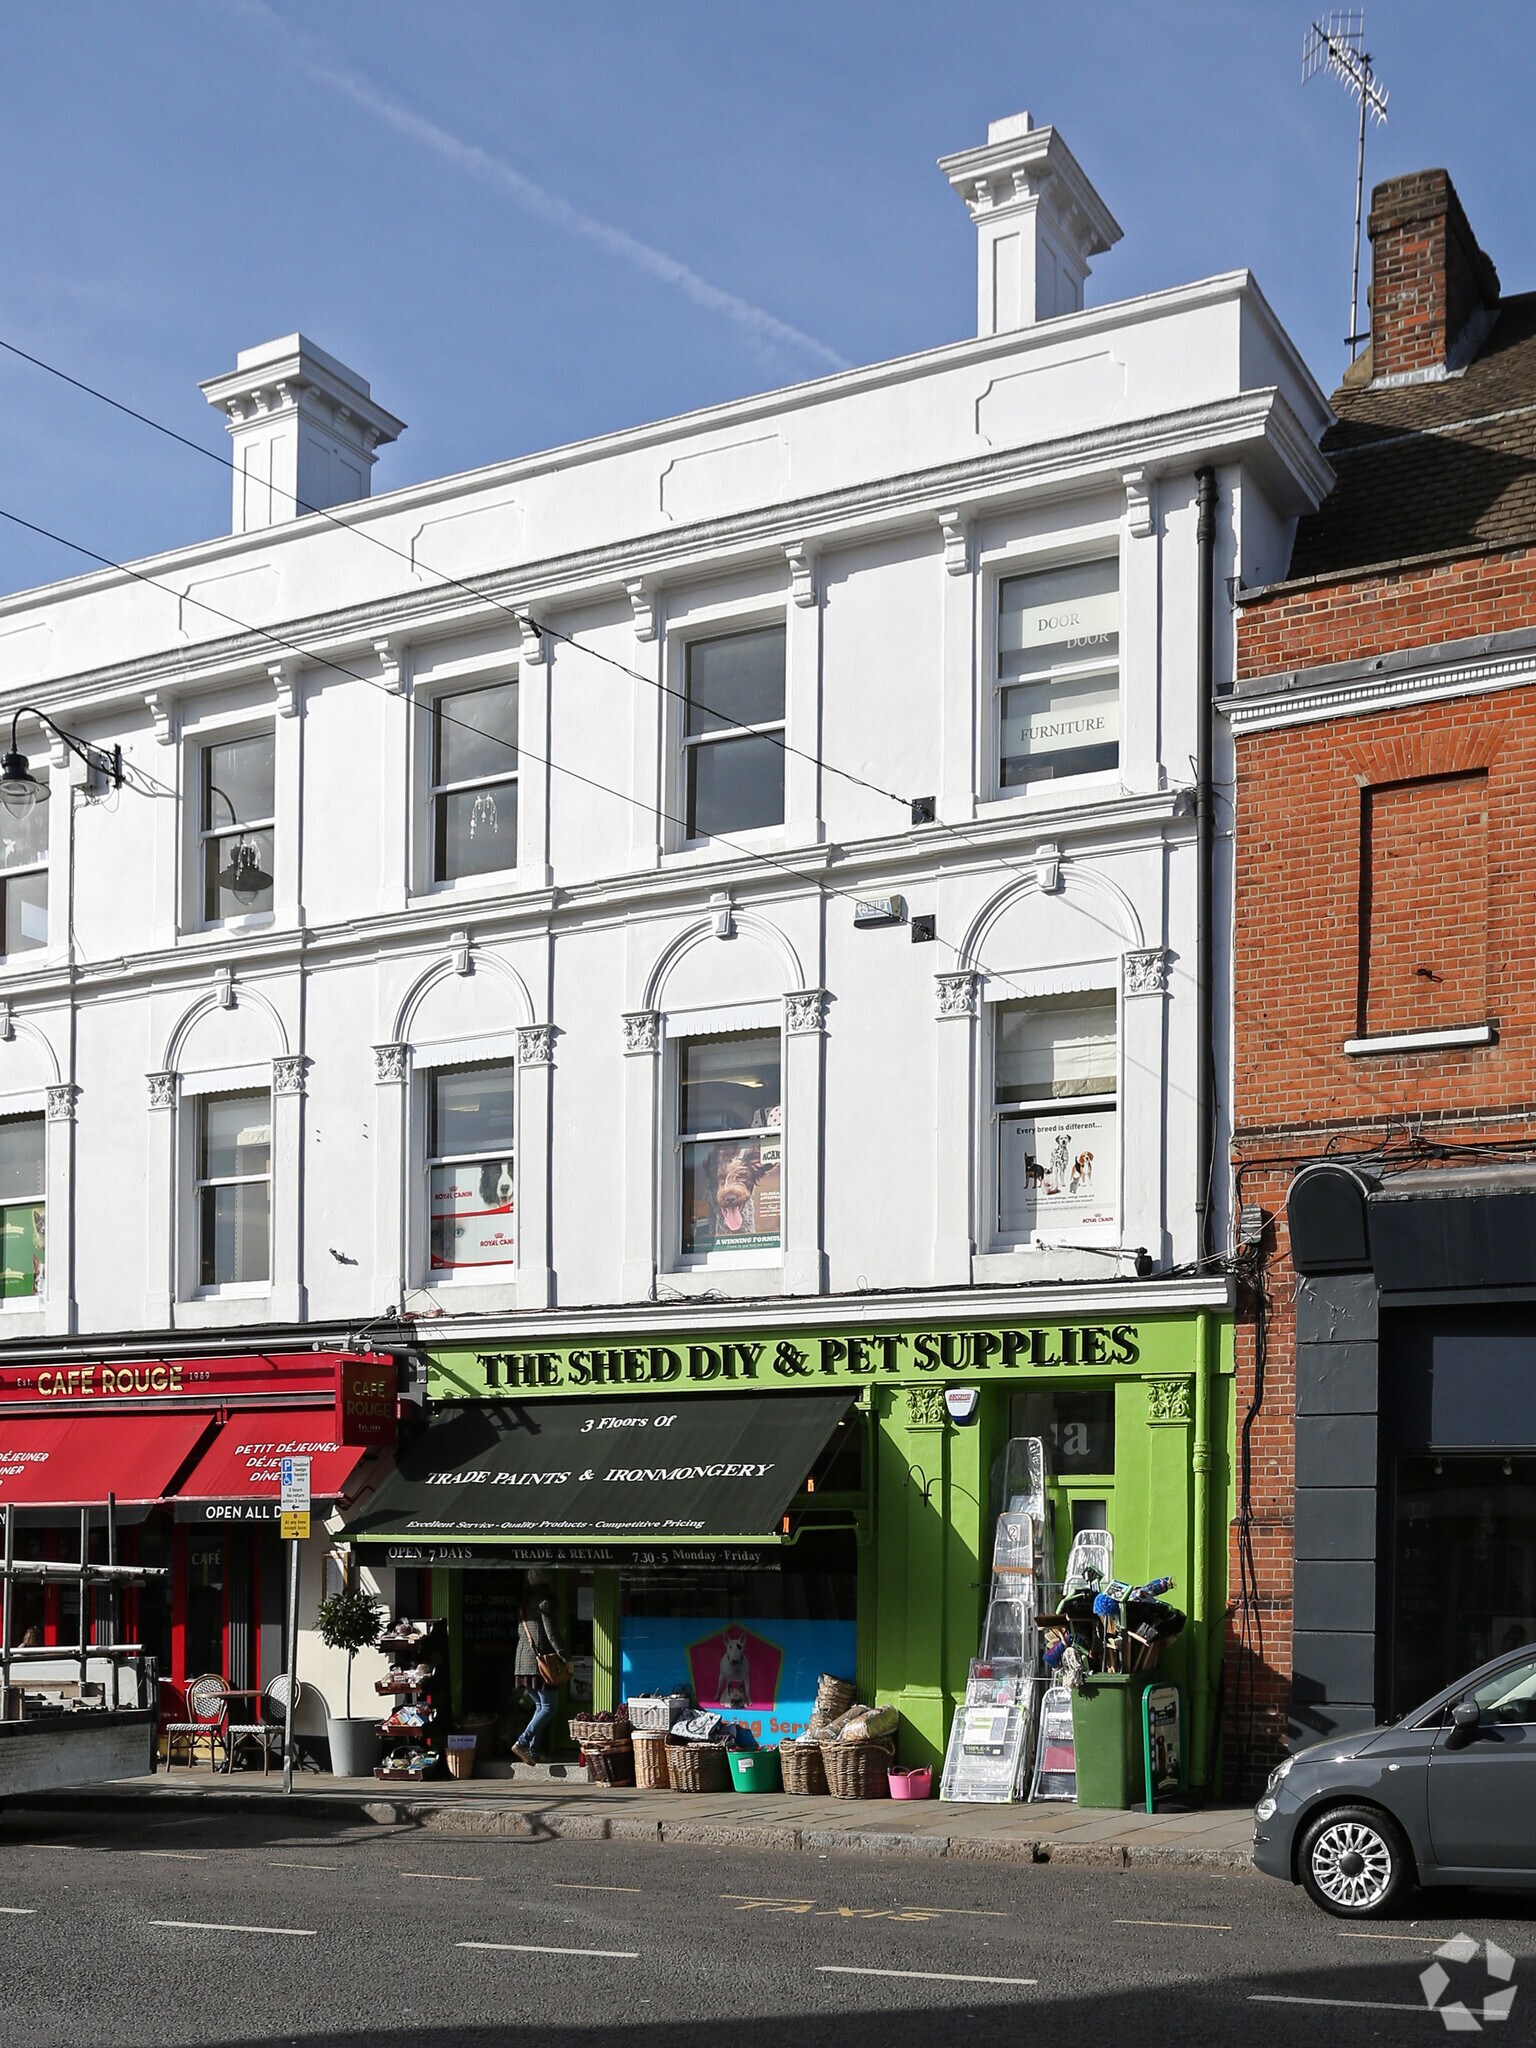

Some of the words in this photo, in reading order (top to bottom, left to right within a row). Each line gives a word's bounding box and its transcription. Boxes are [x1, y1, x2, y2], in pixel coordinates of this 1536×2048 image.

[1038, 613, 1080, 631] DOOR
[1020, 717, 1105, 741] FURNITURE
[1016, 1127, 1036, 1135] Every
[1037, 1125, 1057, 1133] breed
[762, 1150, 781, 1161] ACAN
[454, 1191, 473, 1199] CANIN
[477, 1352, 563, 1388] THE
[568, 1347, 681, 1384] SHED
[686, 1343, 765, 1380] DIY
[773, 1341, 813, 1377] &
[818, 1333, 907, 1375] PET
[914, 1325, 1139, 1371] SUPPLIES
[17, 1377, 32, 1387] Est.
[37, 1366, 96, 1396] CAFÉ
[102, 1366, 183, 1393] ROUGE
[189, 1371, 210, 1380] 1989
[353, 1380, 386, 1398] CAFÉ
[347, 1400, 391, 1418] ROUGE
[580, 1419, 594, 1433] 3
[596, 1415, 648, 1430] Floors
[653, 1414, 678, 1428] Of
[235, 1444, 275, 1455] PETIT
[425, 1470, 491, 1485] TRADE
[490, 1471, 572, 1486] PAINTS
[577, 1469, 595, 1482] &
[602, 1463, 775, 1482] IRONMONGERY
[206, 1507, 241, 1518] OPEN
[245, 1506, 269, 1518] ALL
[406, 1520, 456, 1528] Excellent
[456, 1521, 494, 1529] Service
[500, 1521, 539, 1530] Quality
[538, 1520, 586, 1528] Products
[594, 1520, 661, 1529] Competitive
[661, 1519, 706, 1529] Pricing
[191, 1549, 222, 1566] CAFÉ
[388, 1547, 422, 1558] OPEN
[429, 1549, 436, 1562] 7
[438, 1547, 472, 1558] DAYS
[512, 1549, 553, 1558] TRADE
[557, 1549, 567, 1558] &
[570, 1549, 613, 1559] RETAIL
